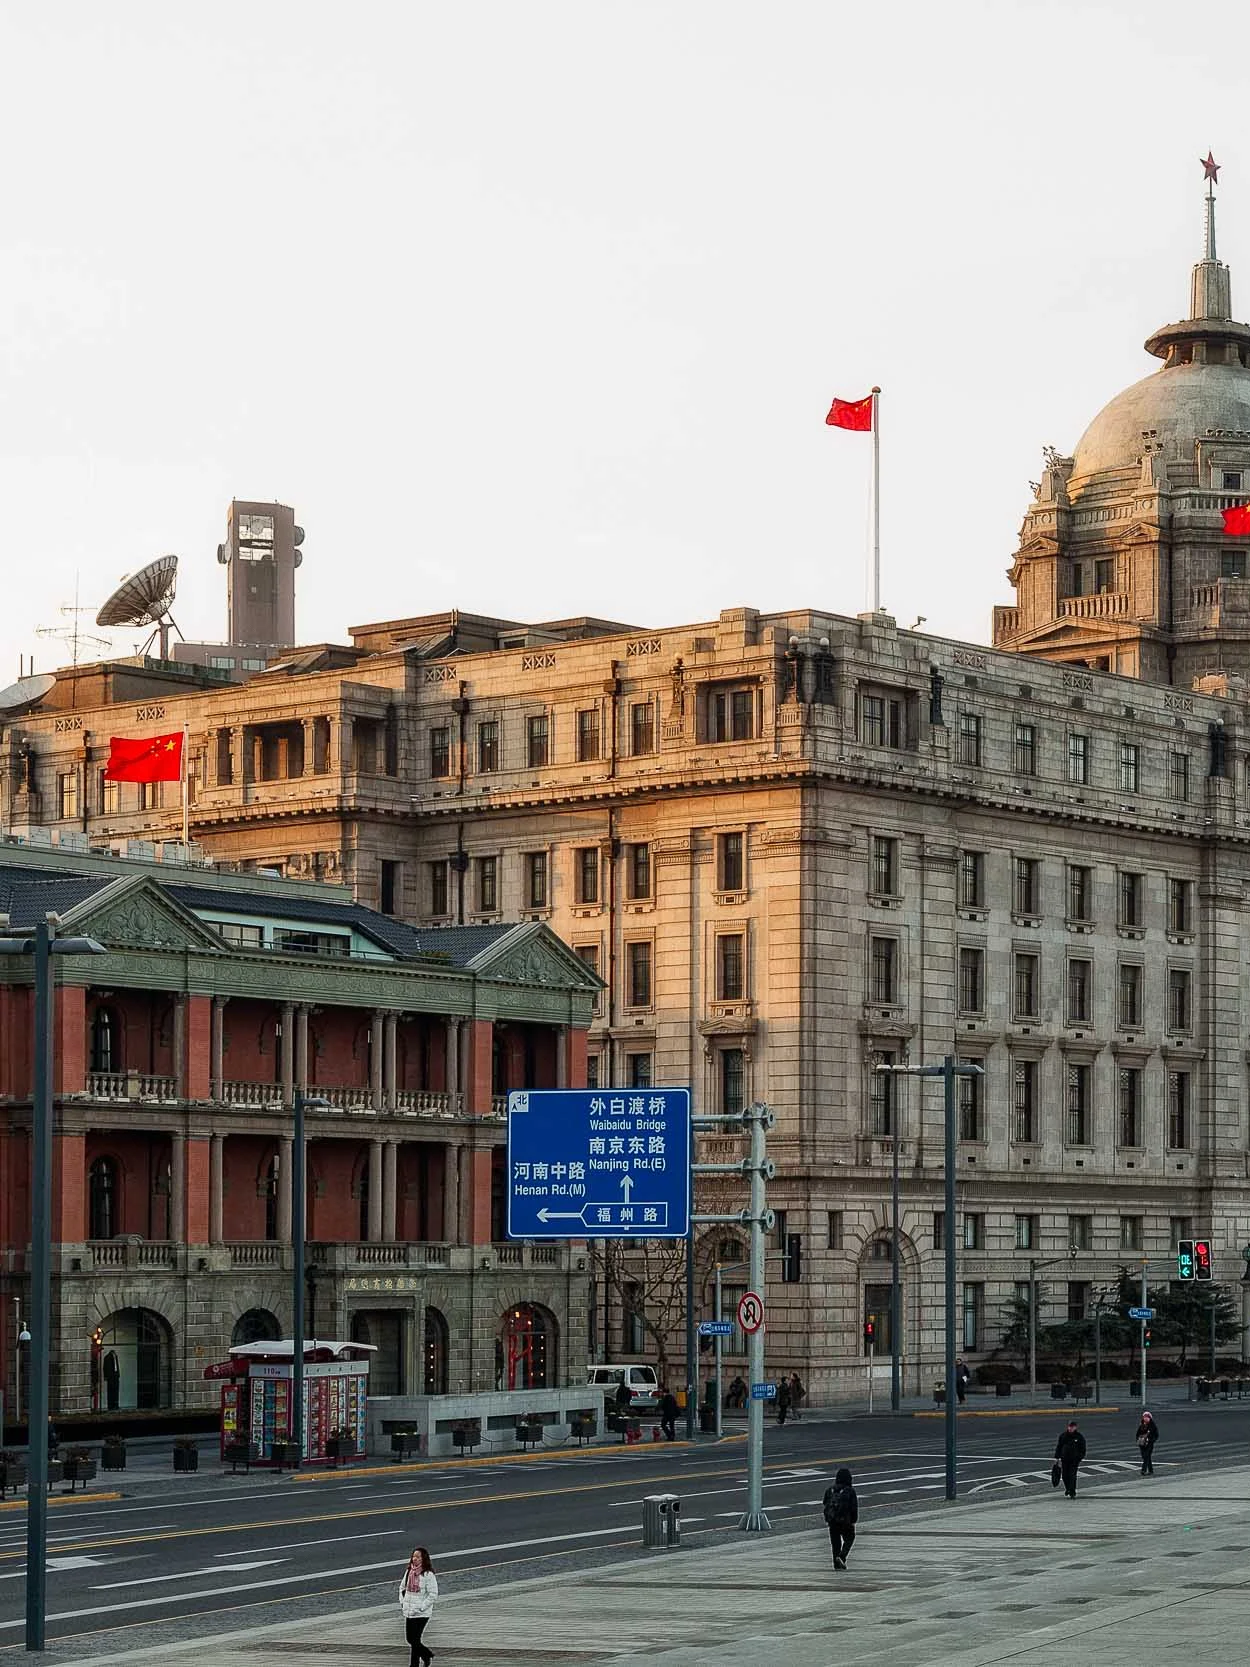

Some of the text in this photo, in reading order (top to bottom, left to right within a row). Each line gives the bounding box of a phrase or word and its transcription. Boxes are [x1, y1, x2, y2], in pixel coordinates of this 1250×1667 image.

[517, 1095, 527, 1105] 北
[589, 1097, 666, 1116] 外白渡桥
[590, 1119, 666, 1132] Waibaidu Bridge
[589, 1136, 666, 1155] 南京东路
[513, 1161, 586, 1180] 河南中路
[589, 1158, 666, 1172] Nanjing Rd.(E)
[515, 1184, 586, 1197] Henan Rd.(M)
[597, 1207, 658, 1222] 福州路
